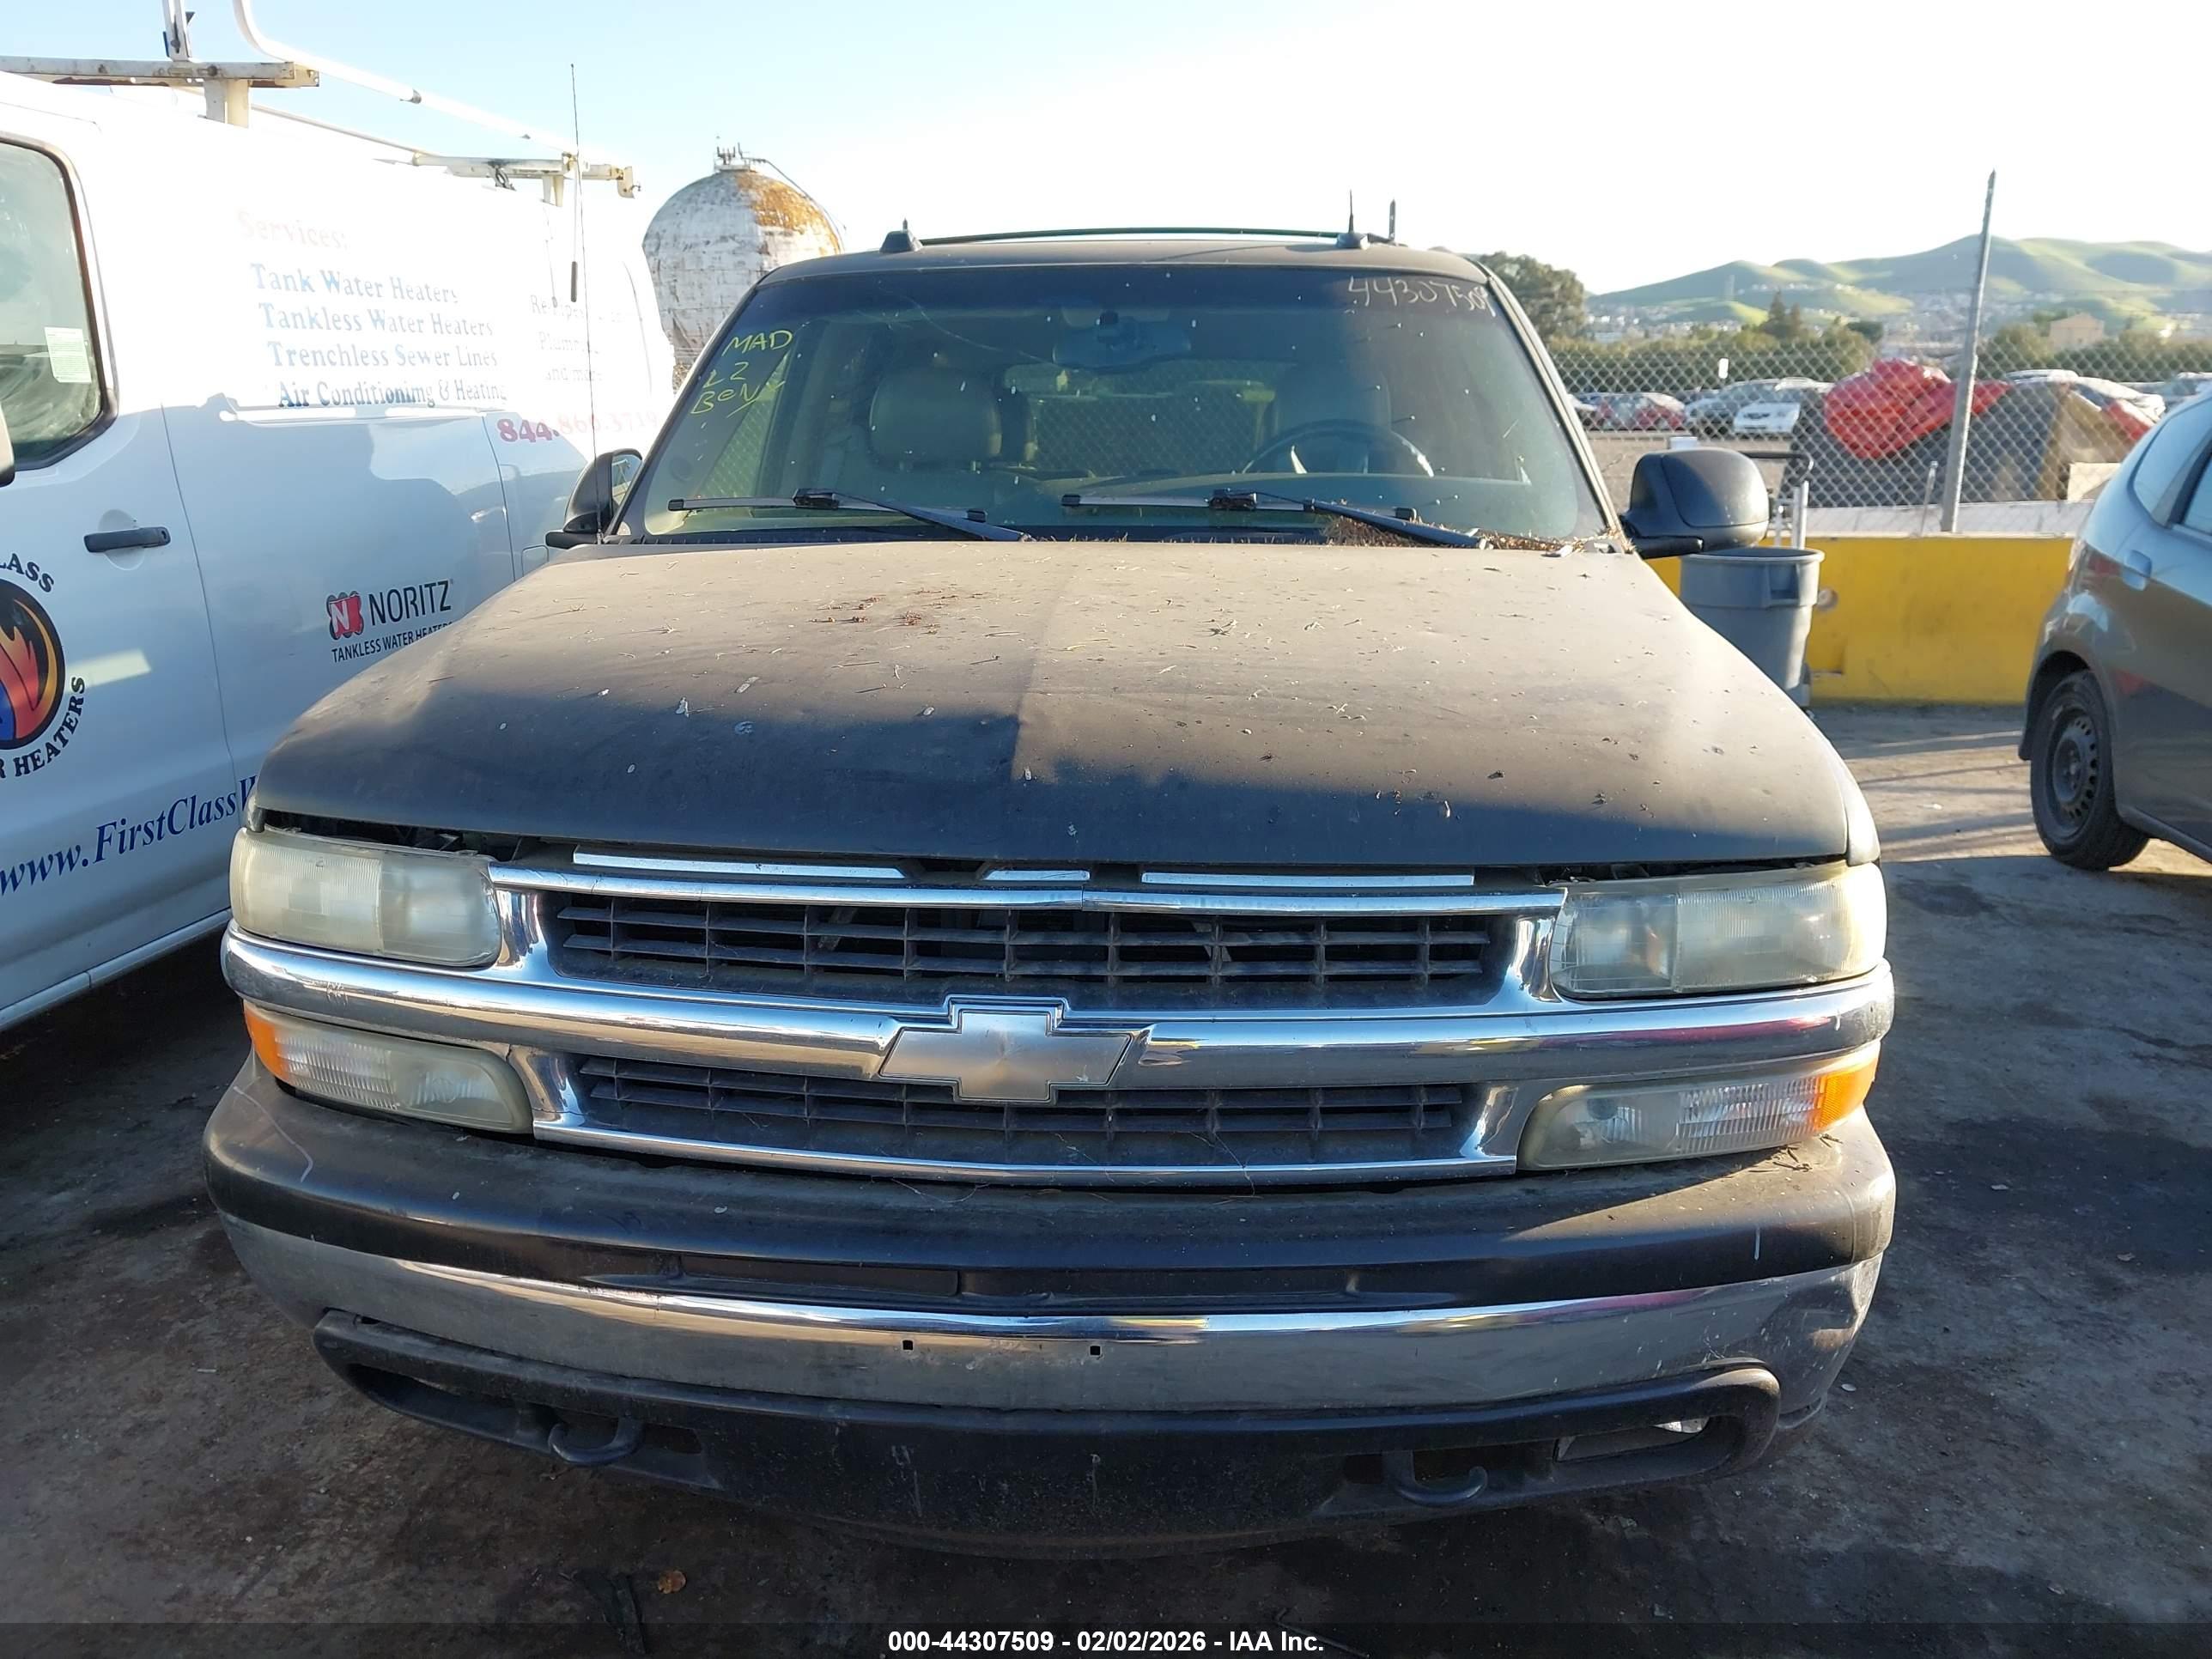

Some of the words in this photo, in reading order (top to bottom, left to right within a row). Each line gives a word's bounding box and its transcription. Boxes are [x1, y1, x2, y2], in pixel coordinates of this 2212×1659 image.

[250, 262, 315, 292] Tank
[319, 270, 383, 298] Water
[389, 276, 458, 303] Heaters
[259, 302, 362, 331] Tankless
[368, 309, 424, 332] Water
[431, 313, 493, 336] Heaters
[267, 341, 389, 367] Trenchless
[395, 343, 450, 368] Sewer
[456, 344, 497, 368] Lines
[721, 330, 793, 356] MAD
[277, 381, 310, 408] Air
[439, 380, 450, 399] &
[368, 580, 452, 626] NORITZ
[331, 638, 381, 662] TANKLESS
[382, 631, 414, 651] WATER
[14, 676, 85, 777] HEATERS
